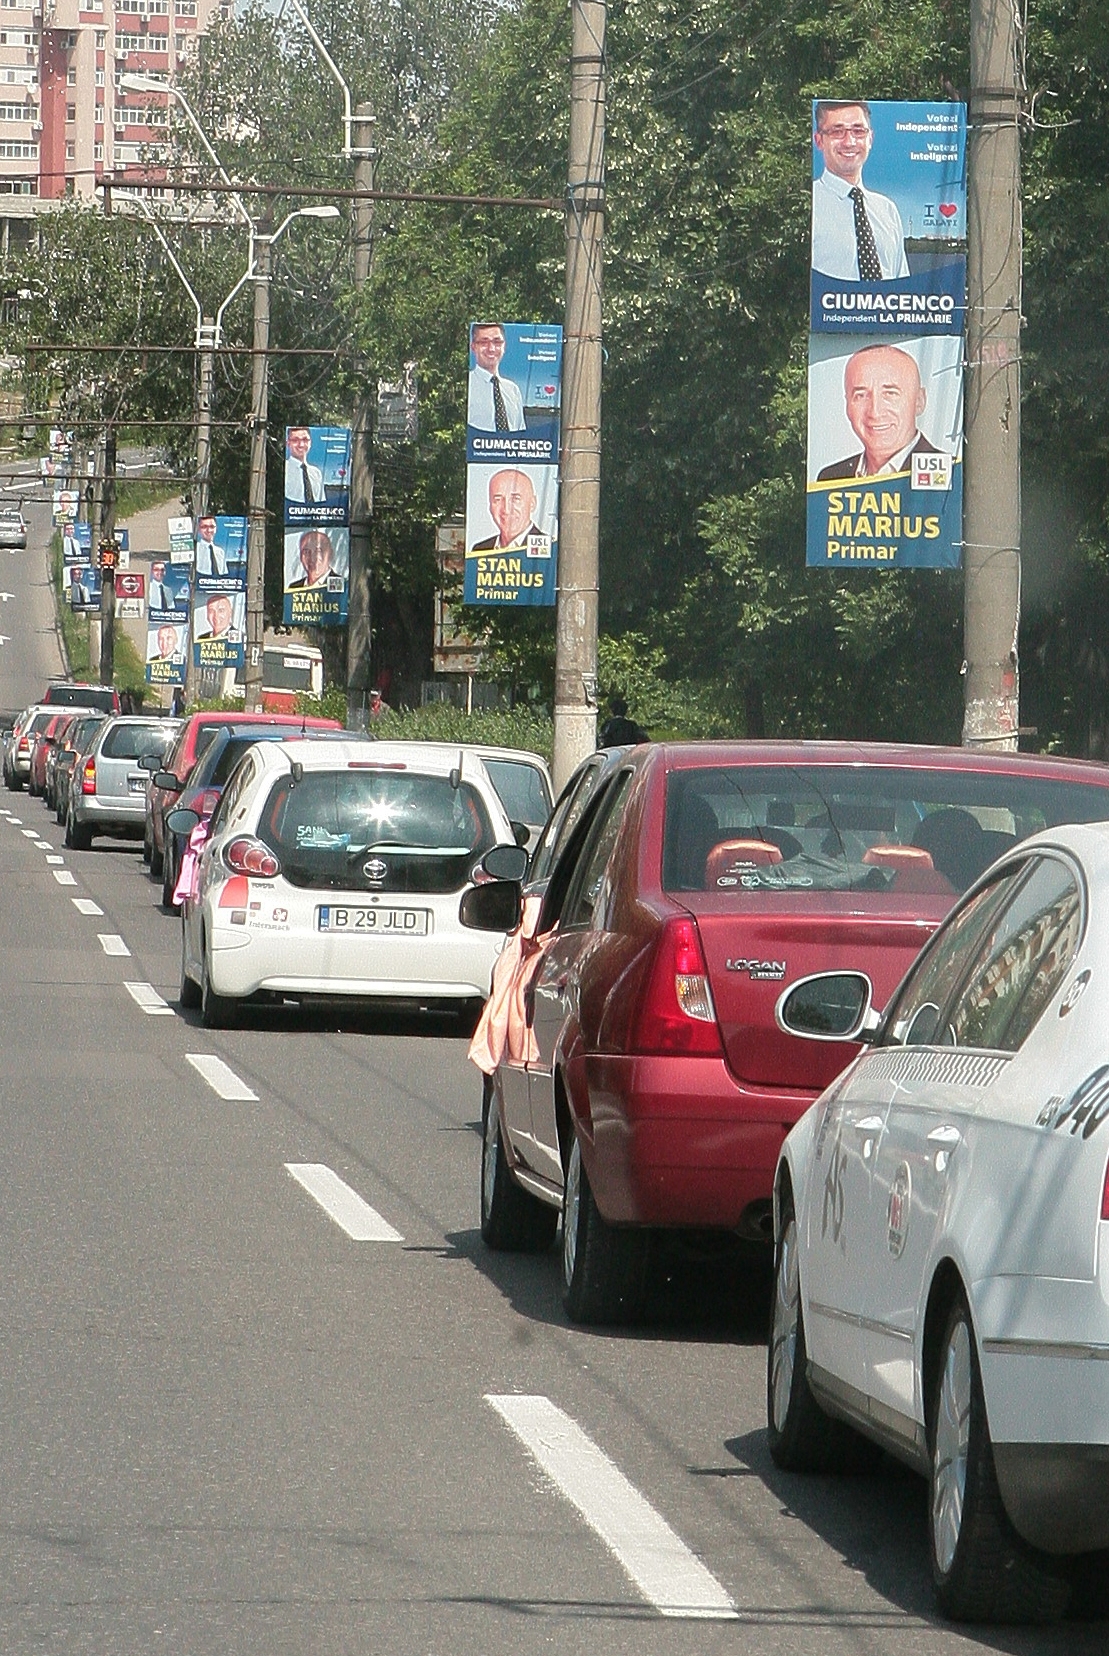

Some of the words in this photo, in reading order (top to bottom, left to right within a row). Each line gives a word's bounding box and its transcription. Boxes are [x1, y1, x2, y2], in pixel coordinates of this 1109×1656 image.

[896, 122, 958, 133] Independent
[910, 151, 958, 163] Inteligent
[924, 204, 935, 217] I
[821, 293, 955, 311] CIUMACENCO
[822, 313, 877, 324] Independent
[879, 313, 895, 323] LA
[473, 438, 553, 451] CIUMACENCO
[917, 457, 947, 471] USL
[827, 491, 901, 514] STAN
[827, 515, 941, 540] MARIUS
[530, 537, 549, 547] USL
[826, 540, 899, 561] Primar
[477, 557, 521, 573] STAN
[476, 572, 544, 588] MARIUS
[292, 592, 323, 603] STAN
[476, 588, 519, 600] Primar
[292, 602, 340, 613] MARIUS
[336, 909, 349, 926] B
[355, 910, 377, 927] 29
[383, 911, 417, 929] JLD
[726, 958, 787, 971] LOGAN
